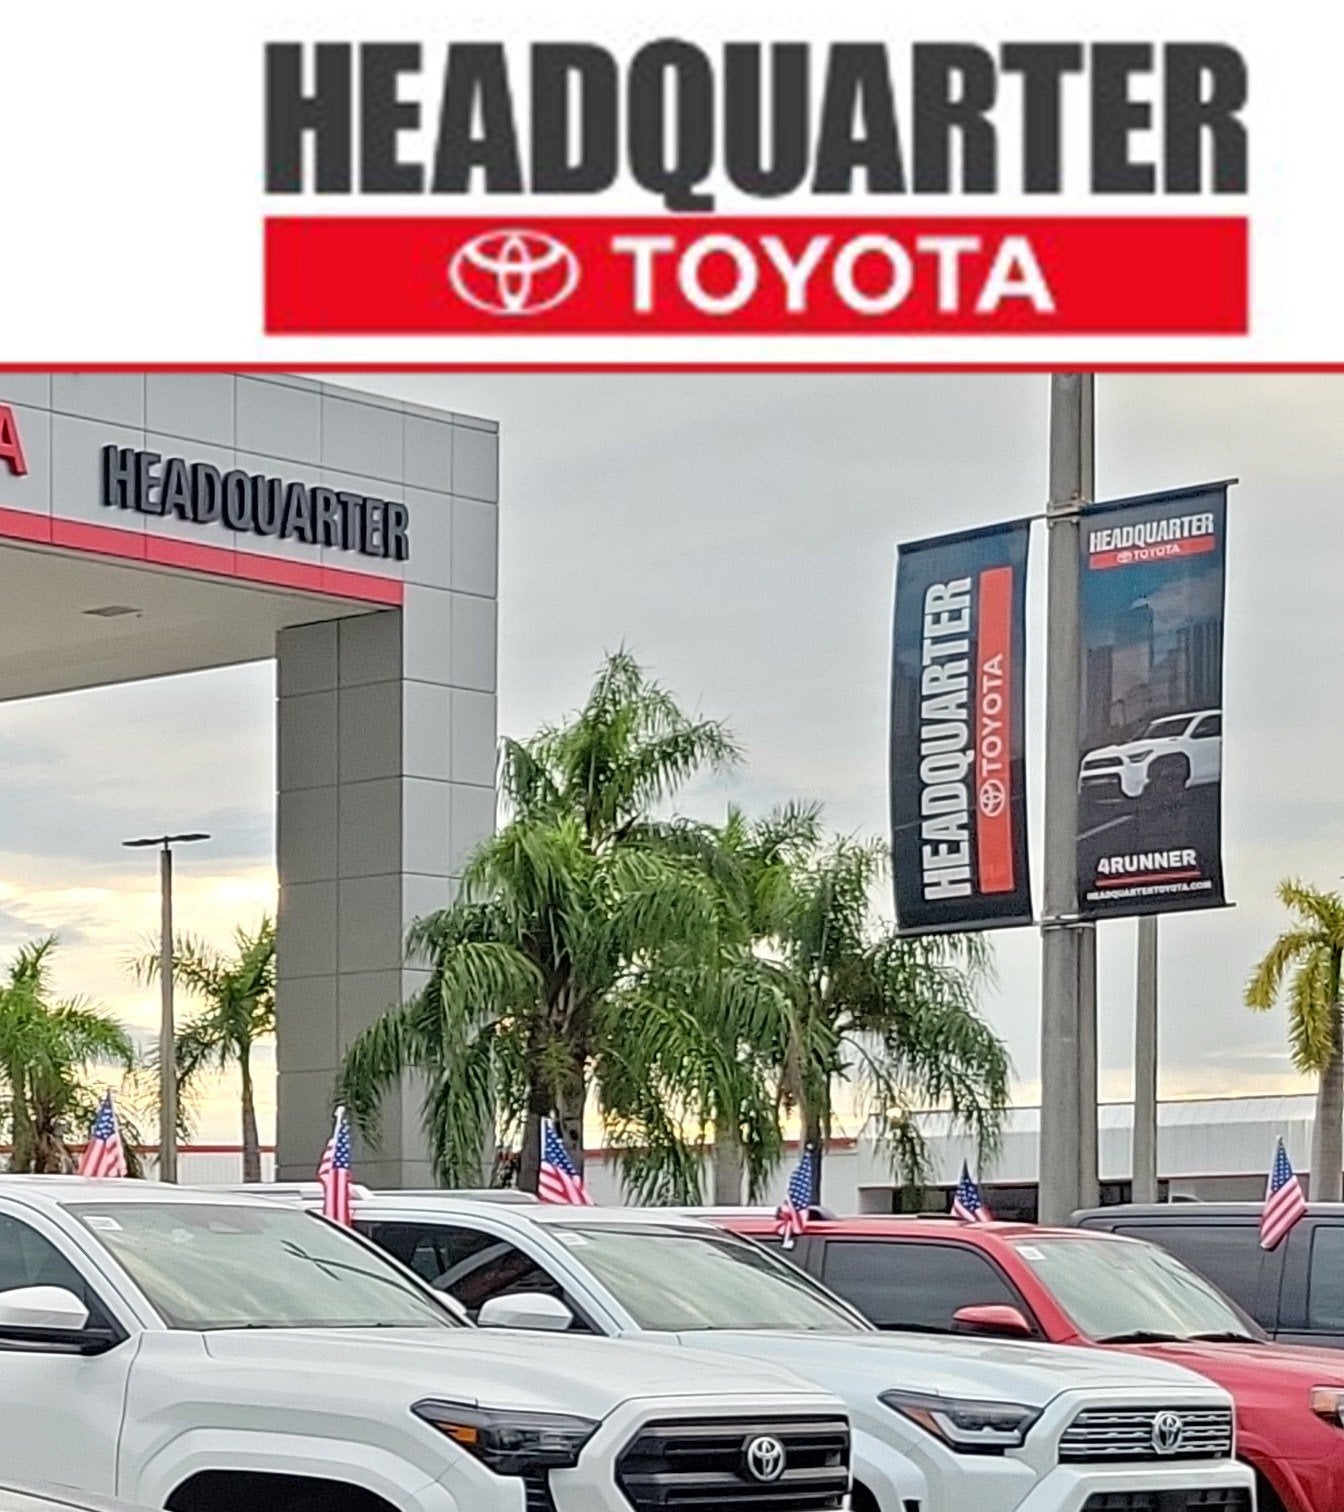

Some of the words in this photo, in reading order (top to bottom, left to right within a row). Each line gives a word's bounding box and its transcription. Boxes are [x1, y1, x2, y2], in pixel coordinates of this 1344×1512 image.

[101, 444, 410, 560] HEADQUARTER
[1089, 512, 1214, 554] HEADQUARTER
[1133, 543, 1180, 561] TOYOTA
[919, 576, 975, 900] HEADQUARTER
[981, 653, 1004, 776] TOYOTA
[1096, 848, 1197, 875] 4RUNNER
